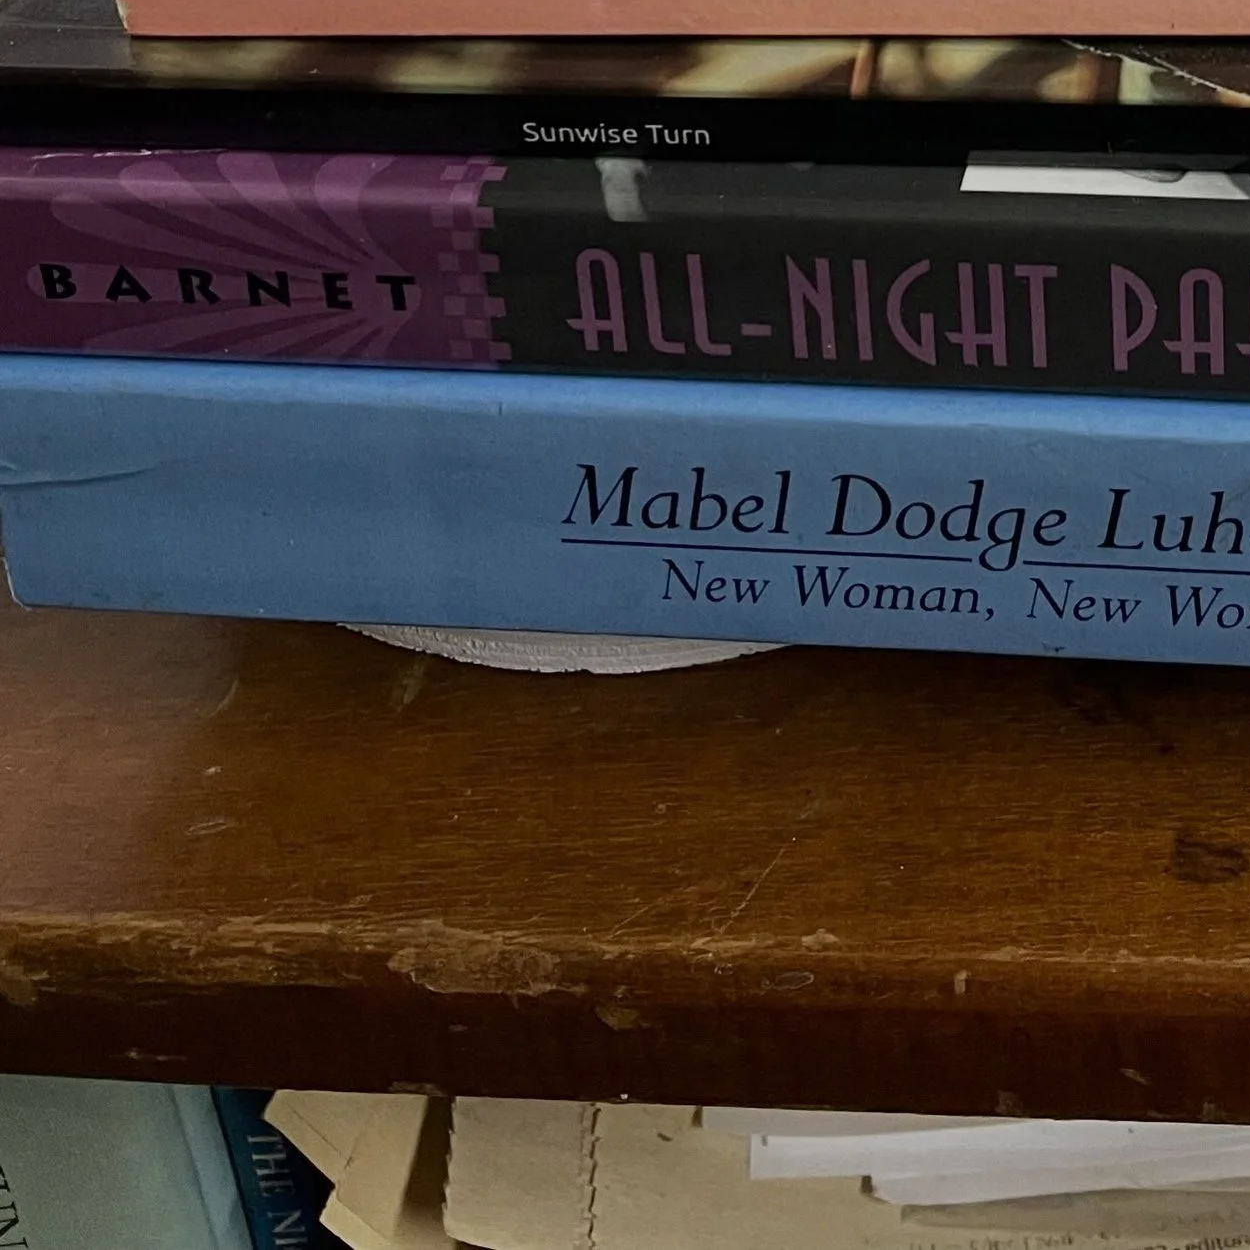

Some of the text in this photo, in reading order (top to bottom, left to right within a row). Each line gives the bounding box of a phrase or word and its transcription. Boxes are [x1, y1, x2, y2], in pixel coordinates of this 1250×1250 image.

[522, 122, 711, 146] Sunwise Turn
[39, 261, 416, 312] BARNET
[566, 247, 1059, 368] ALL-NIGHT
[560, 463, 792, 535] Mabel
[826, 473, 1068, 572] Dodge
[661, 558, 771, 606] New
[793, 563, 997, 622] Woman,
[1027, 577, 1143, 626] New
